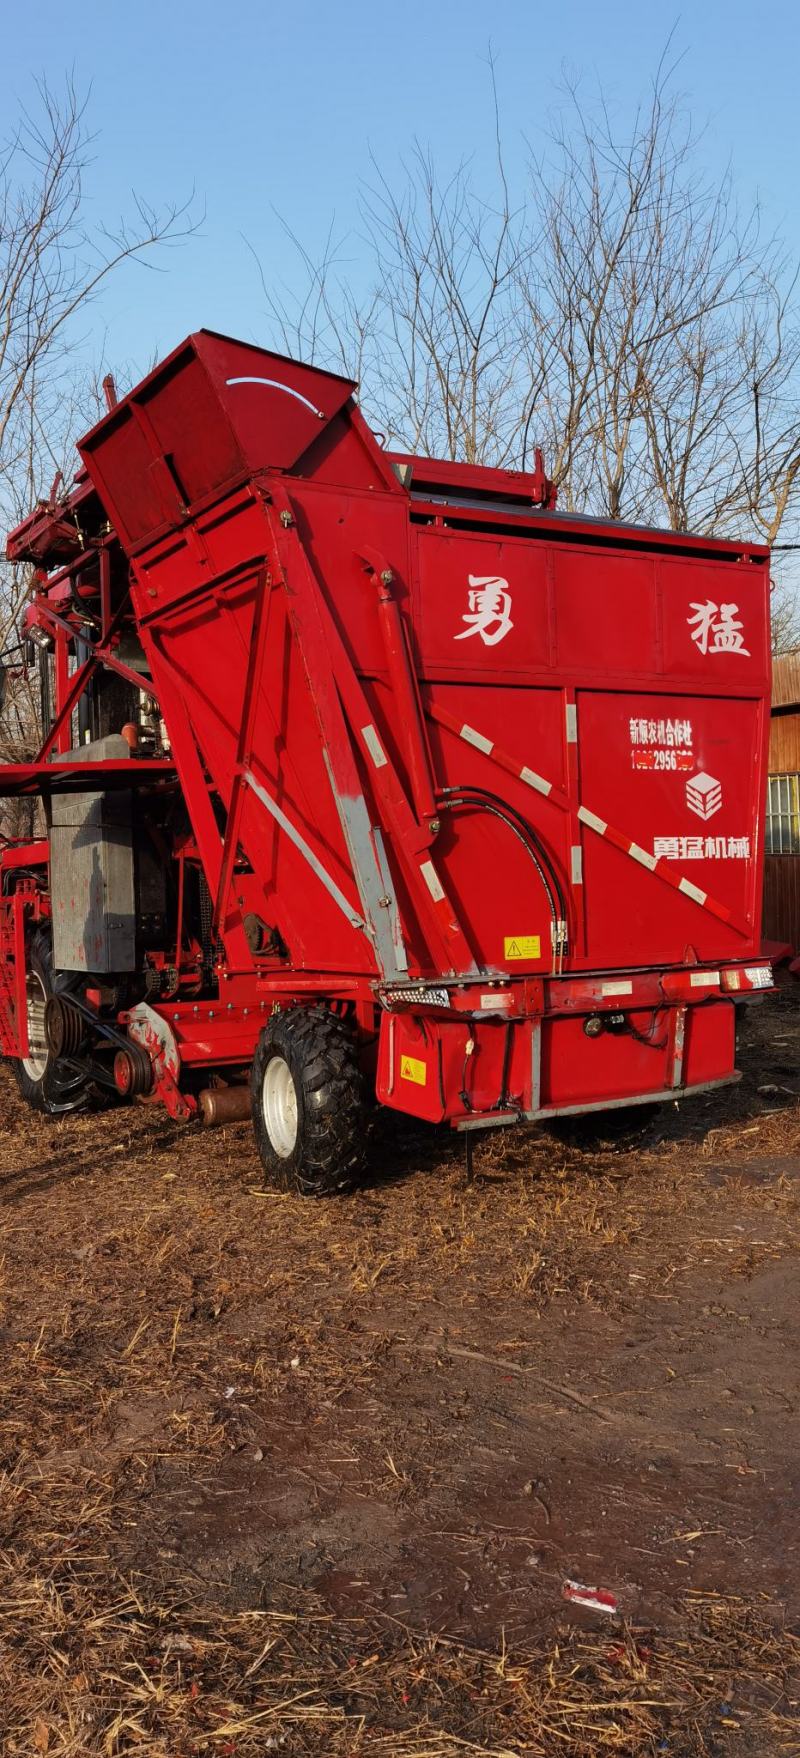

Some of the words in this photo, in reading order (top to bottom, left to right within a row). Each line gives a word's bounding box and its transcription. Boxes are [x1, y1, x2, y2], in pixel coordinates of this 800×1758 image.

[453, 574, 514, 646] 勇
[686, 599, 751, 657] 猛
[653, 836, 750, 860] 勇猛机械
